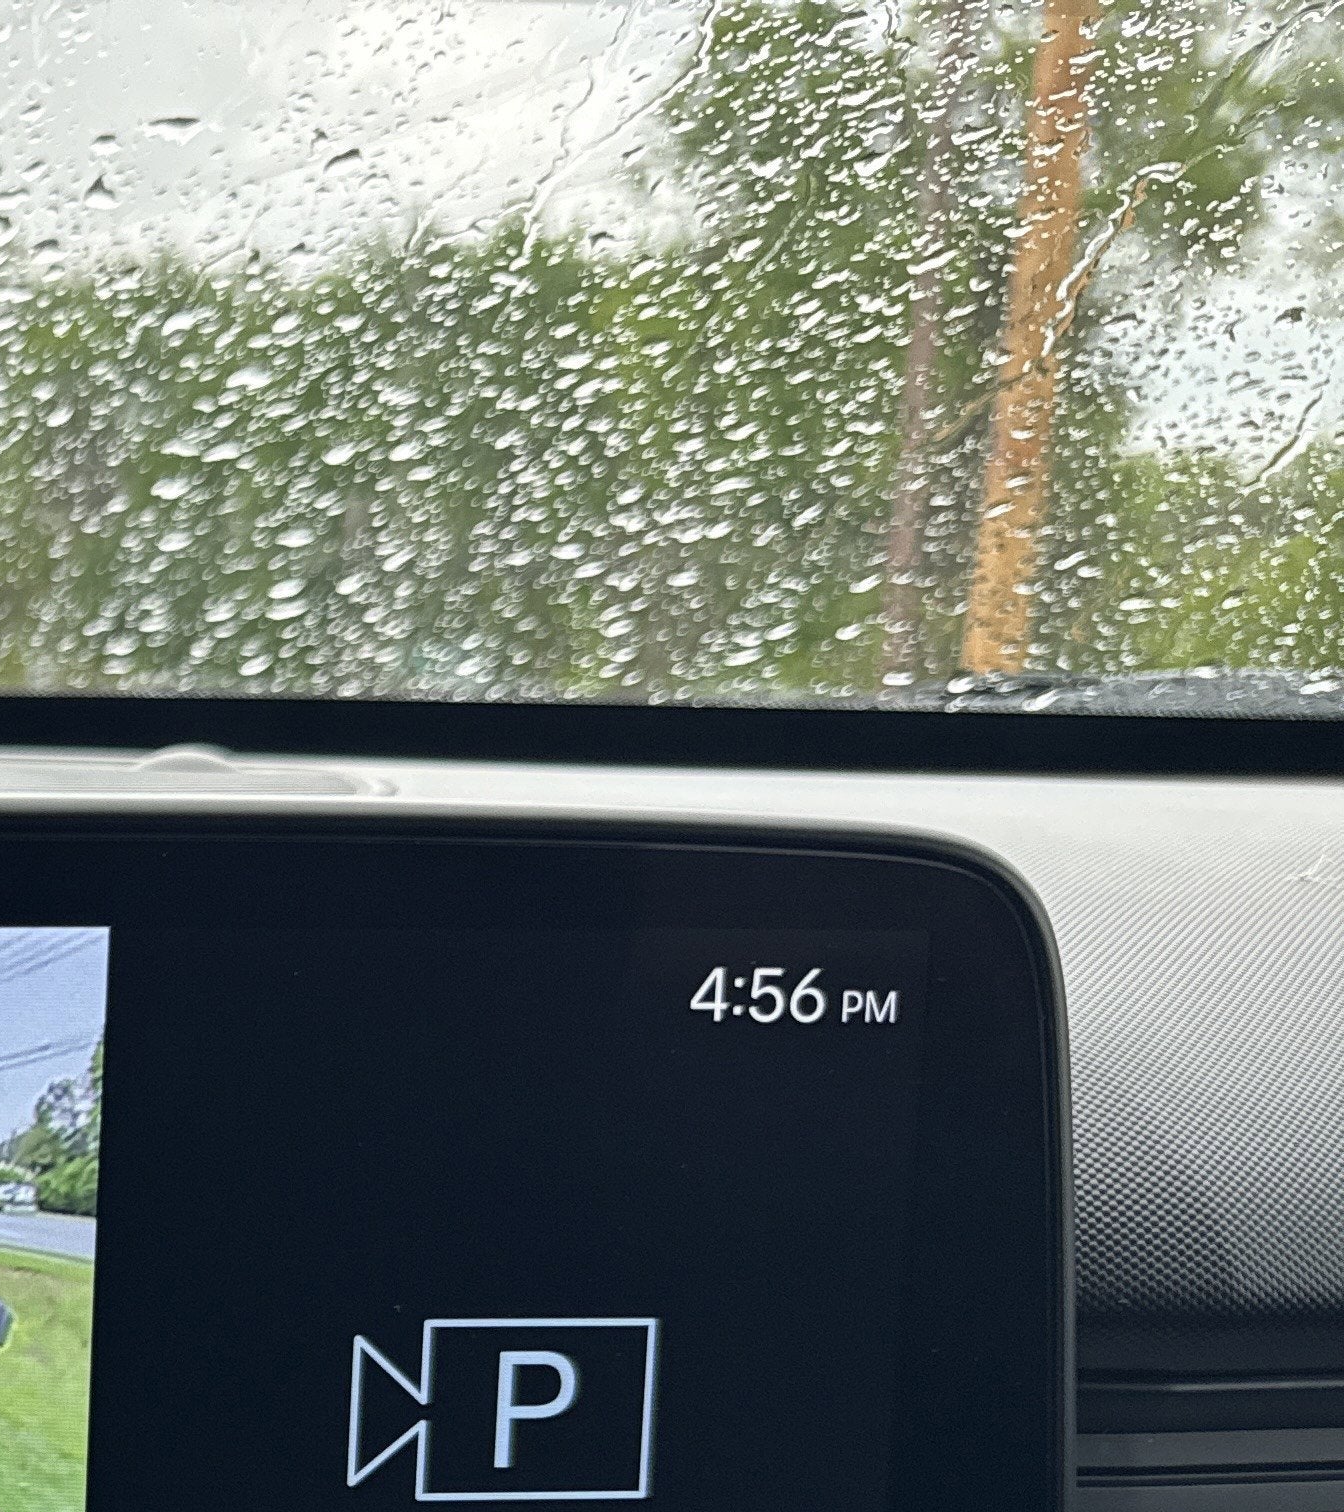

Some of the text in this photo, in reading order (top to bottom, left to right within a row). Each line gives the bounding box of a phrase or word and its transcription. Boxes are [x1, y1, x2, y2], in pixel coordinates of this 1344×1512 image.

[689, 965, 899, 1025] 4:56 PM
[493, 1350, 579, 1469] P
